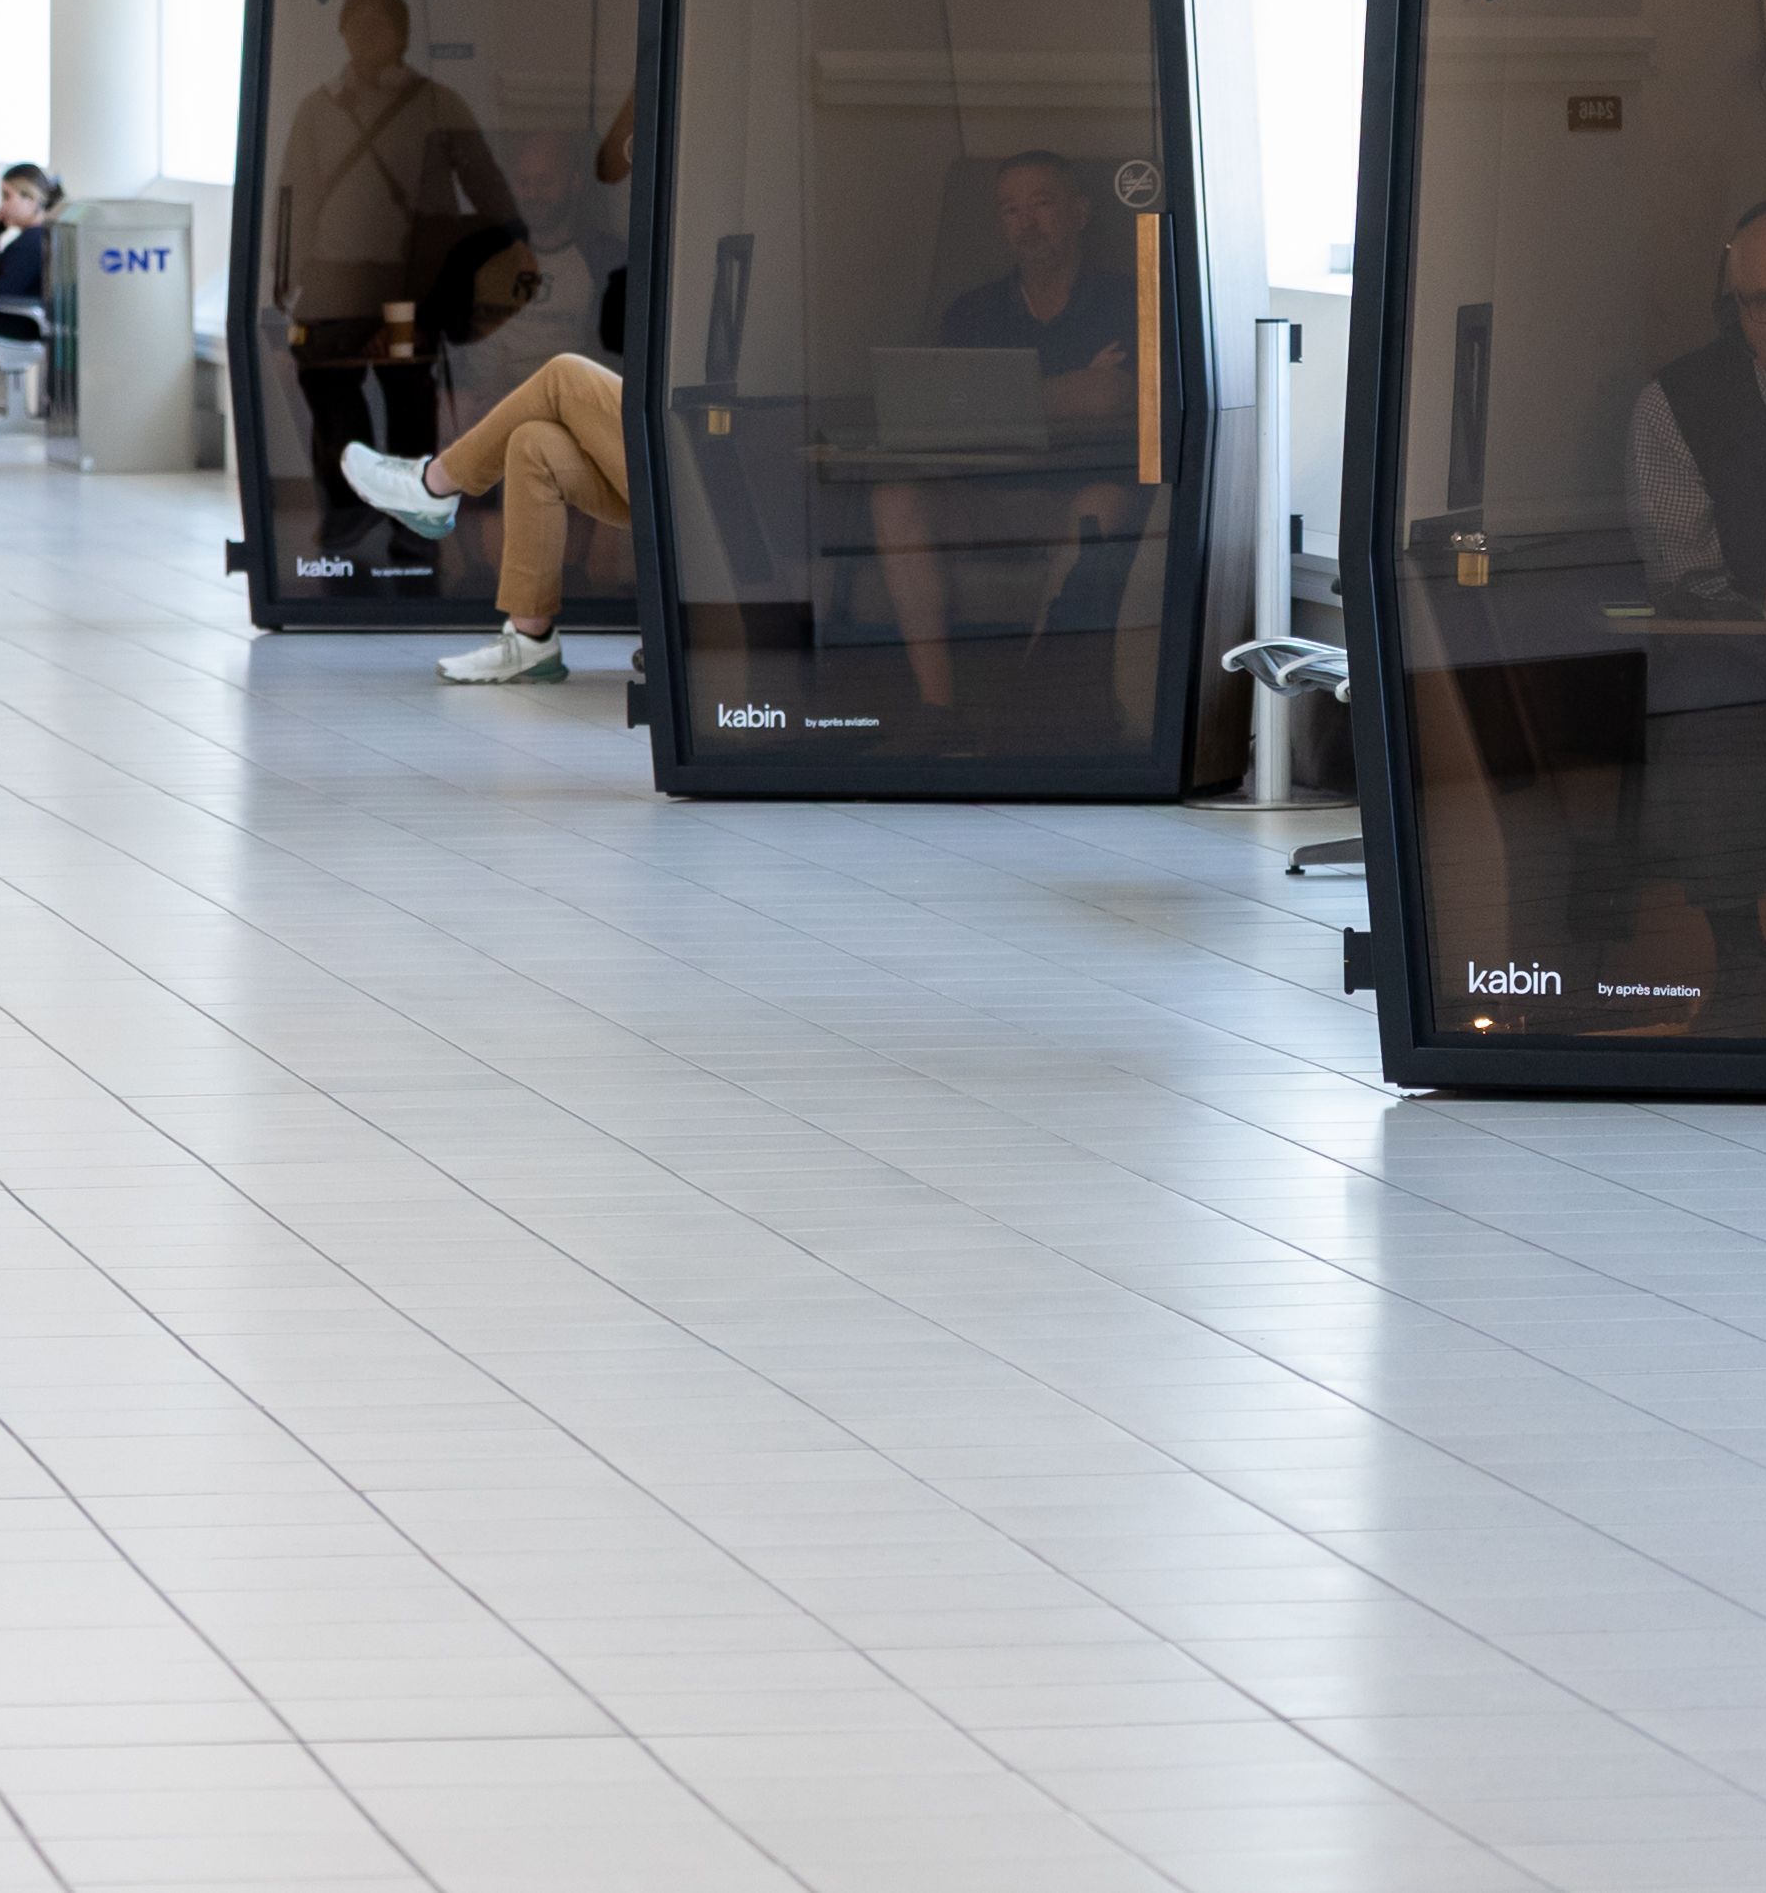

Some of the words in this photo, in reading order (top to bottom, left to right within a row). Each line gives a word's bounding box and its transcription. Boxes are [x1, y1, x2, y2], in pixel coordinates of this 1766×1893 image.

[99, 247, 171, 274] ONT
[296, 555, 353, 578] kabin
[718, 703, 786, 729] kabin
[805, 717, 818, 729] by
[844, 716, 880, 727] aviation
[1468, 961, 1562, 995] kabin
[1598, 982, 1614, 997] by
[1615, 983, 1651, 998] après
[1652, 984, 1701, 997] aviation
